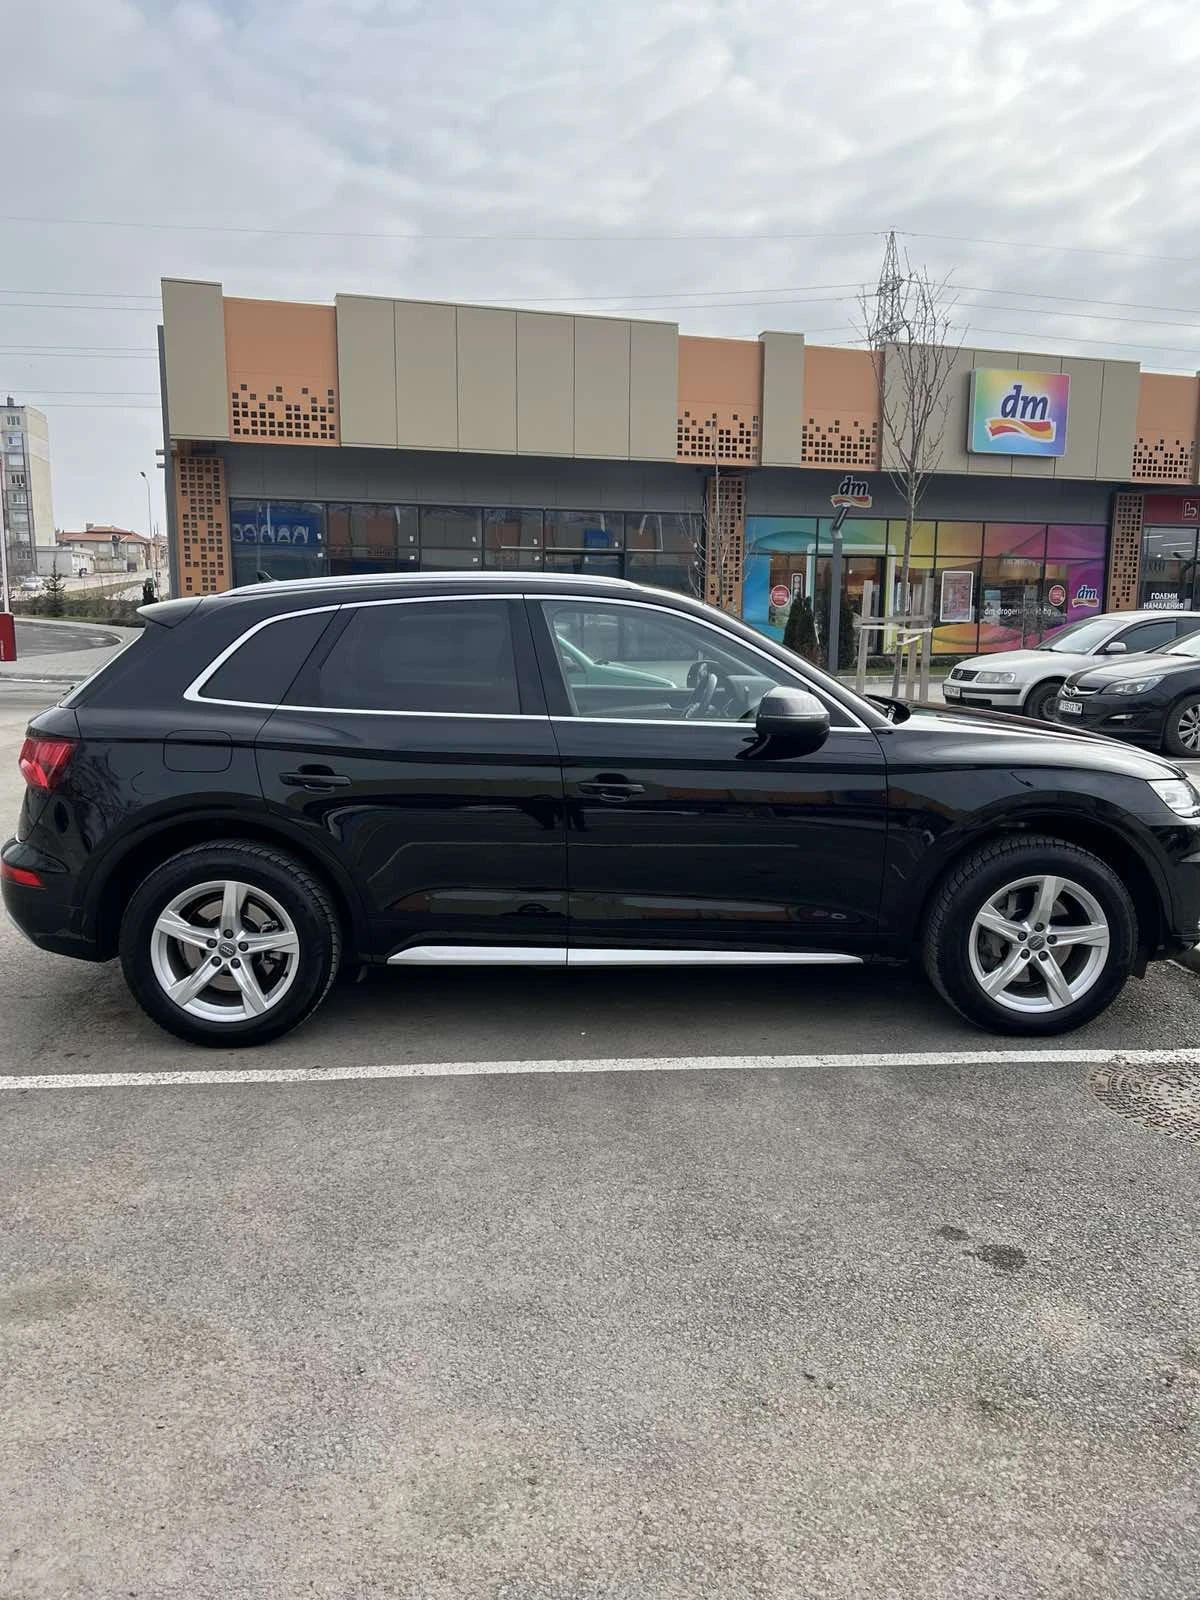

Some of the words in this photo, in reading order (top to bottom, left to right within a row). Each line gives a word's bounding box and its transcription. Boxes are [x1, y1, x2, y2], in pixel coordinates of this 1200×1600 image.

[1000, 384, 1049, 421] dm
[839, 476, 867, 496] dm
[1077, 585, 1097, 600] dm
[1150, 592, 1178, 600] ГОЛЕМИ
